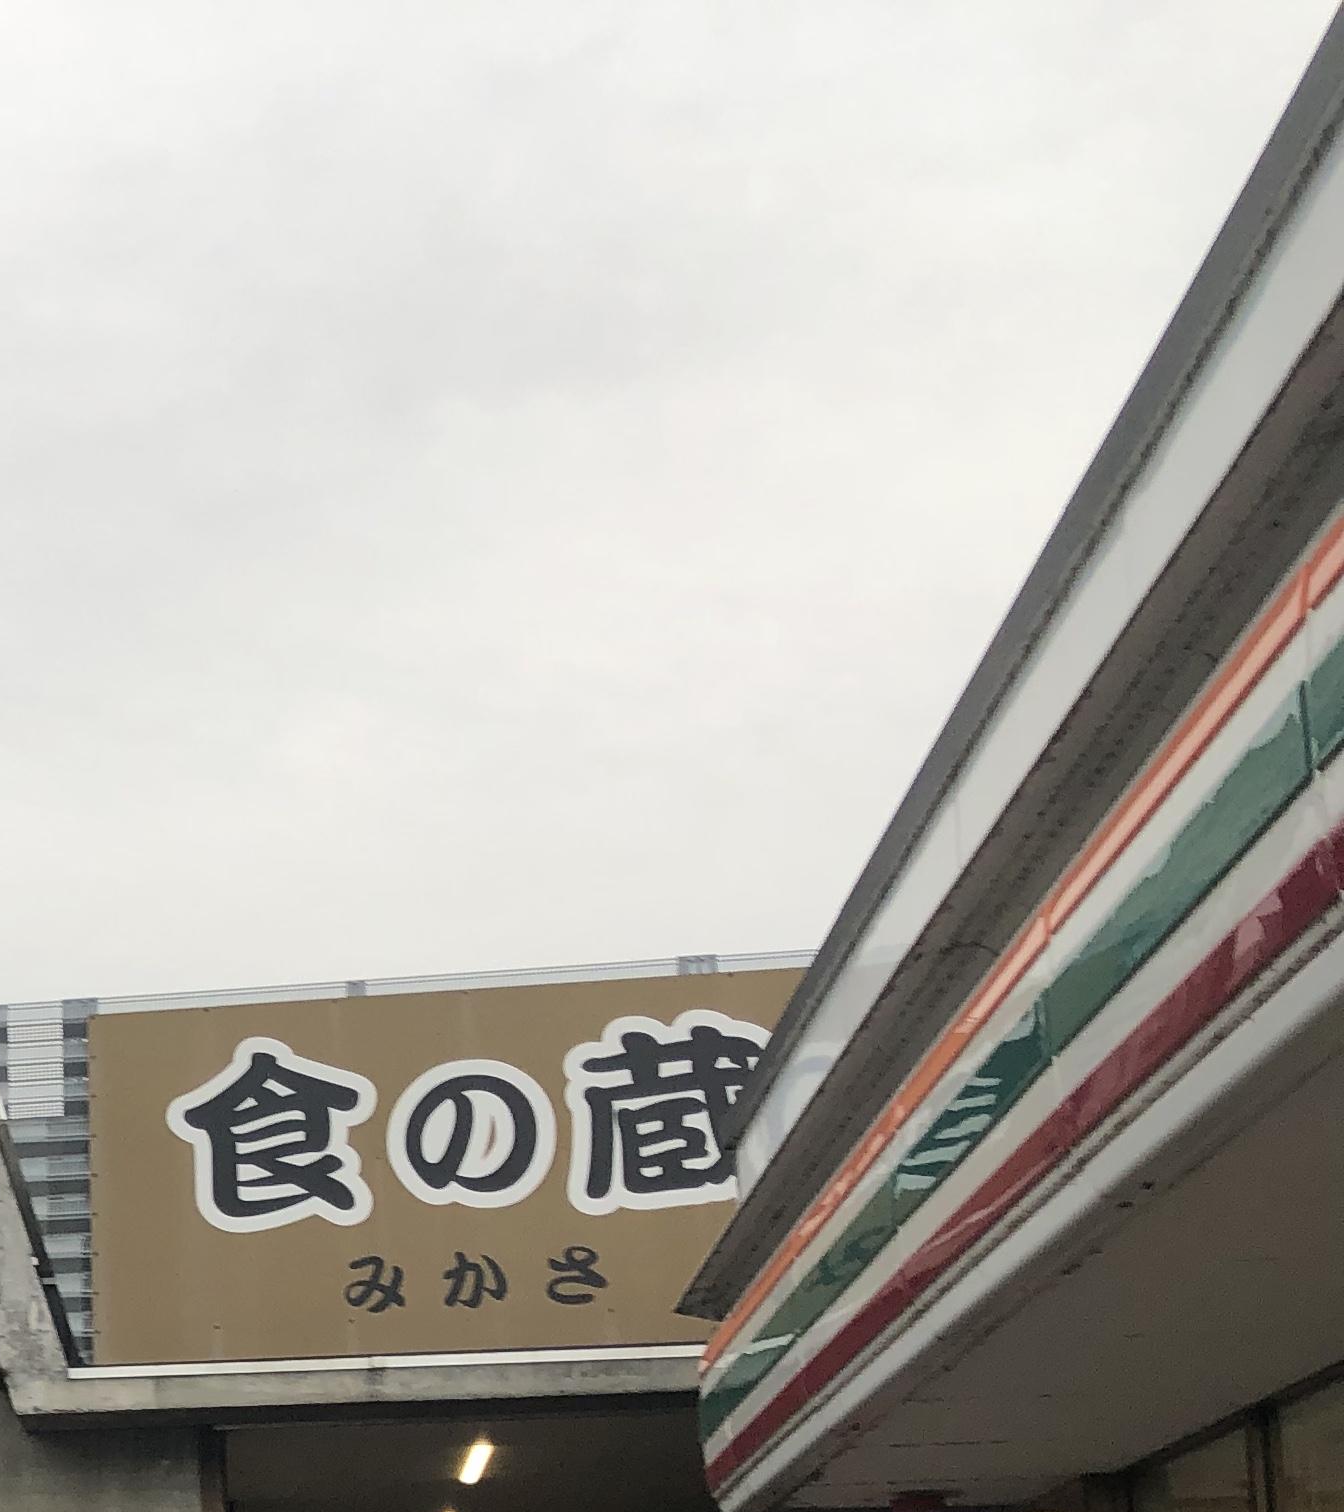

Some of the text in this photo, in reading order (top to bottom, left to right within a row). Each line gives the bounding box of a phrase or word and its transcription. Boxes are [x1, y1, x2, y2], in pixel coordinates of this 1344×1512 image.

[168, 1009, 772, 1233] 食の蔵
[344, 1245, 609, 1313] みかさ
